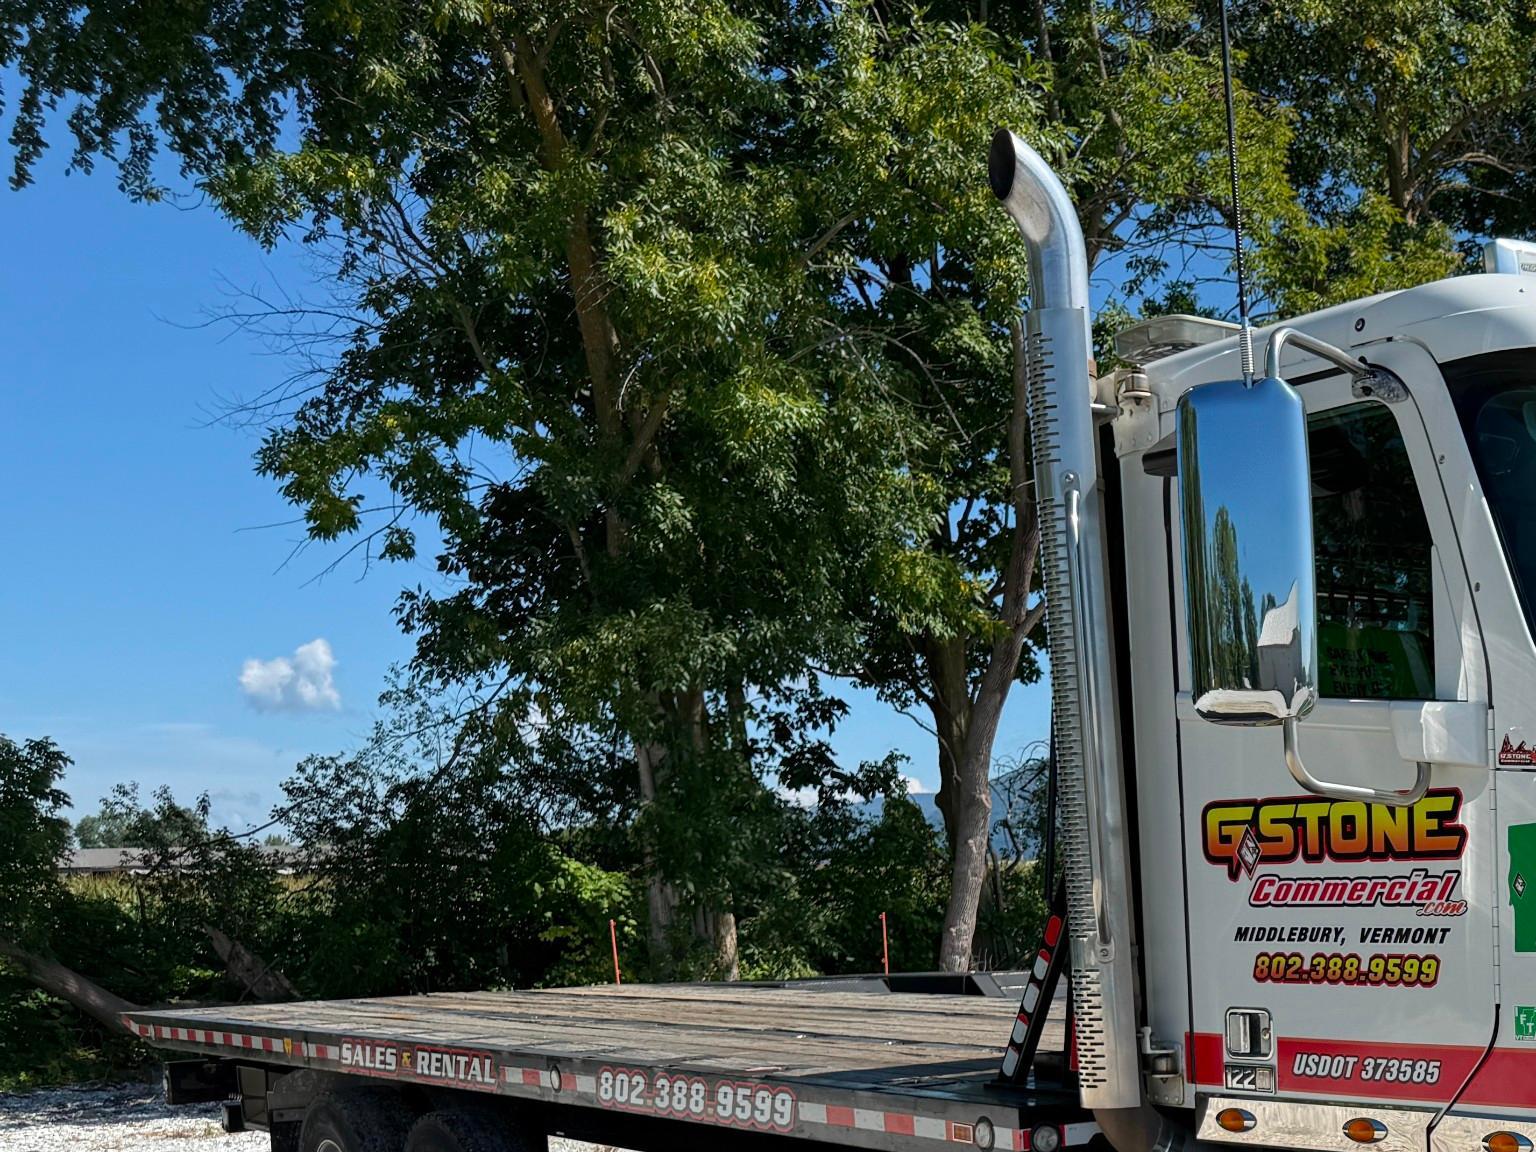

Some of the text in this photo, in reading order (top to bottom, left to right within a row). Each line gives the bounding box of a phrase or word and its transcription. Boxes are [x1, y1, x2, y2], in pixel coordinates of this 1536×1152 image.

[1252, 871, 1458, 906] Commercial
[1234, 927, 1451, 946] MIDDLEBURY, VERMONT
[1255, 954, 1438, 984] 802.388.9599
[341, 1042, 496, 1084] SALES & RENTAL
[1293, 1054, 1441, 1084] USDOT 373585
[599, 1071, 792, 1126] 802.388.9599
